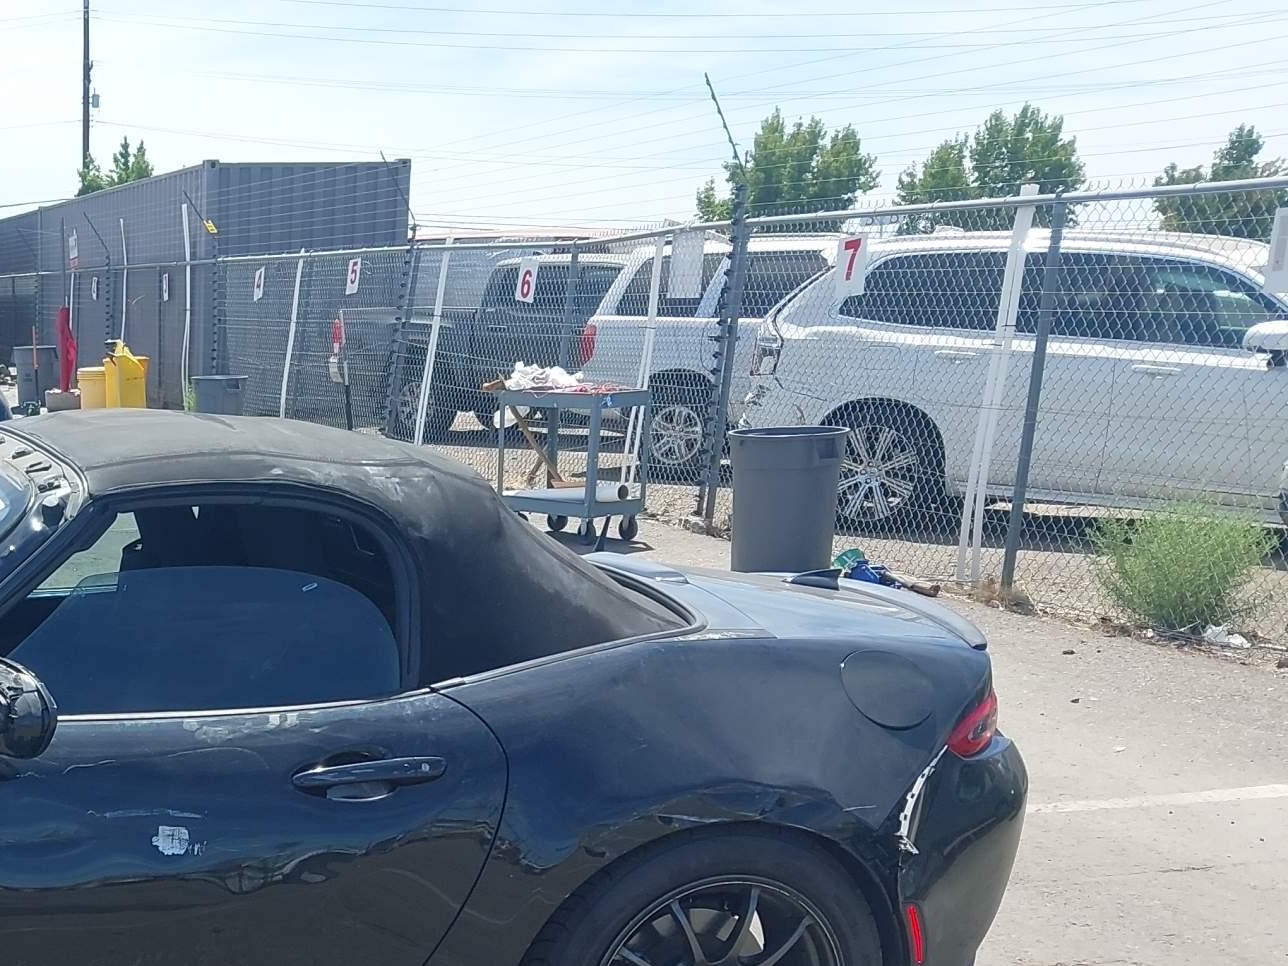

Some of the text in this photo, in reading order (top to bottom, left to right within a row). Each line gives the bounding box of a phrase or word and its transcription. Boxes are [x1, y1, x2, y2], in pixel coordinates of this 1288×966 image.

[350, 260, 359, 285] 5
[844, 238, 862, 281] 7
[256, 270, 263, 289] 4
[520, 269, 532, 299] 6
